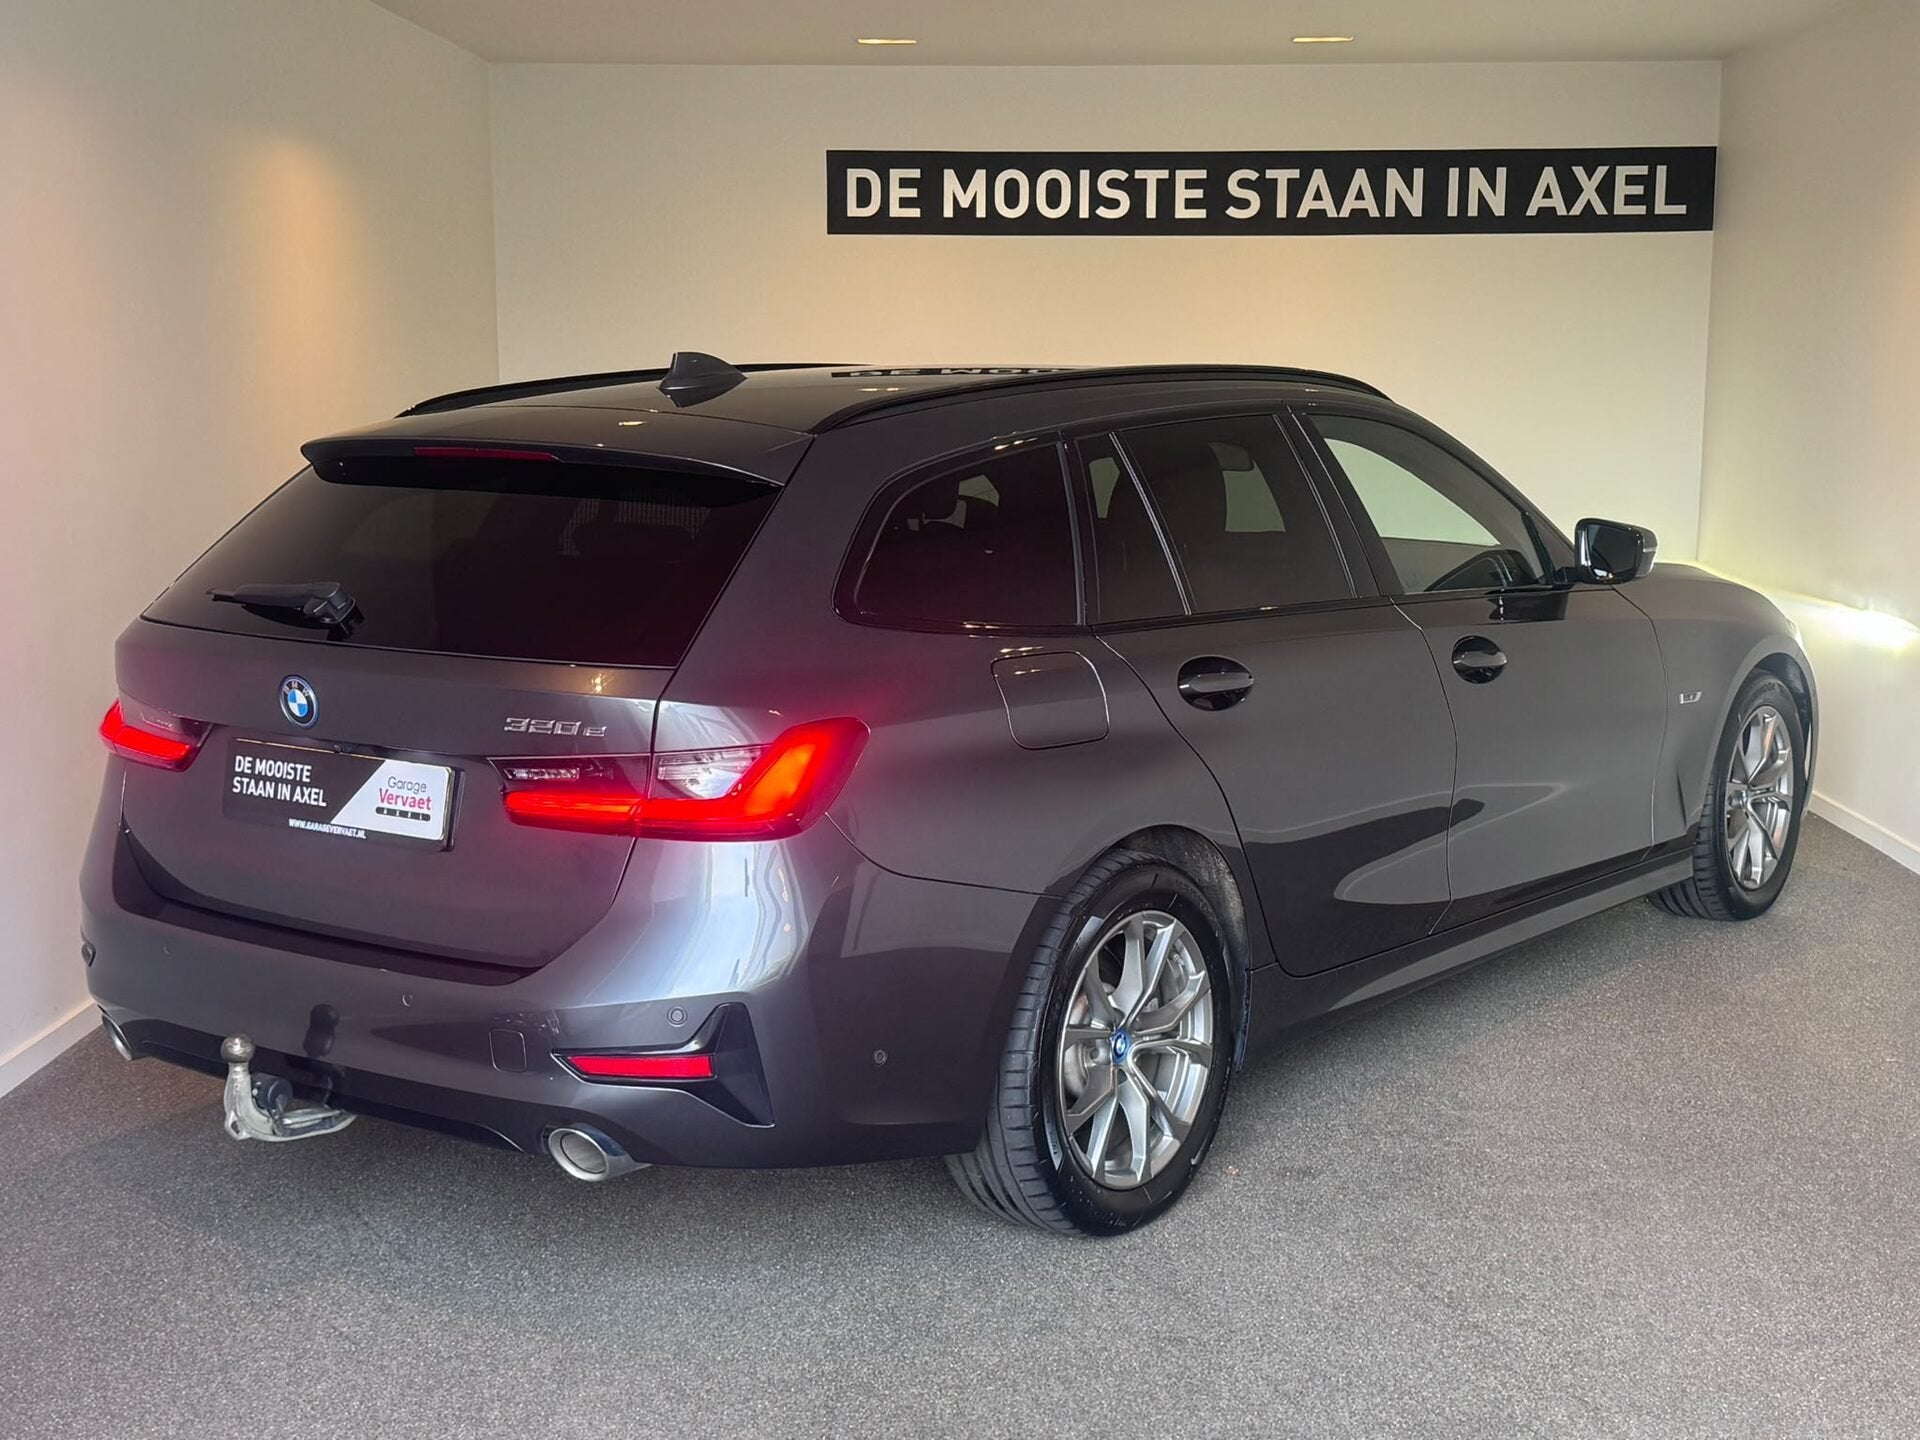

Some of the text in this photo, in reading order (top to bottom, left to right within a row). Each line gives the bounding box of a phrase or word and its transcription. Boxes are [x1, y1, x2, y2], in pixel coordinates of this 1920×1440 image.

[846, 165, 1688, 219] DE MOOISTE STAAN IN AXEL
[234, 755, 312, 783] DE MOOISTE
[232, 776, 327, 807] STAAN IN AXEL
[379, 787, 432, 811] Vervaet
[387, 776, 427, 795] Garage
